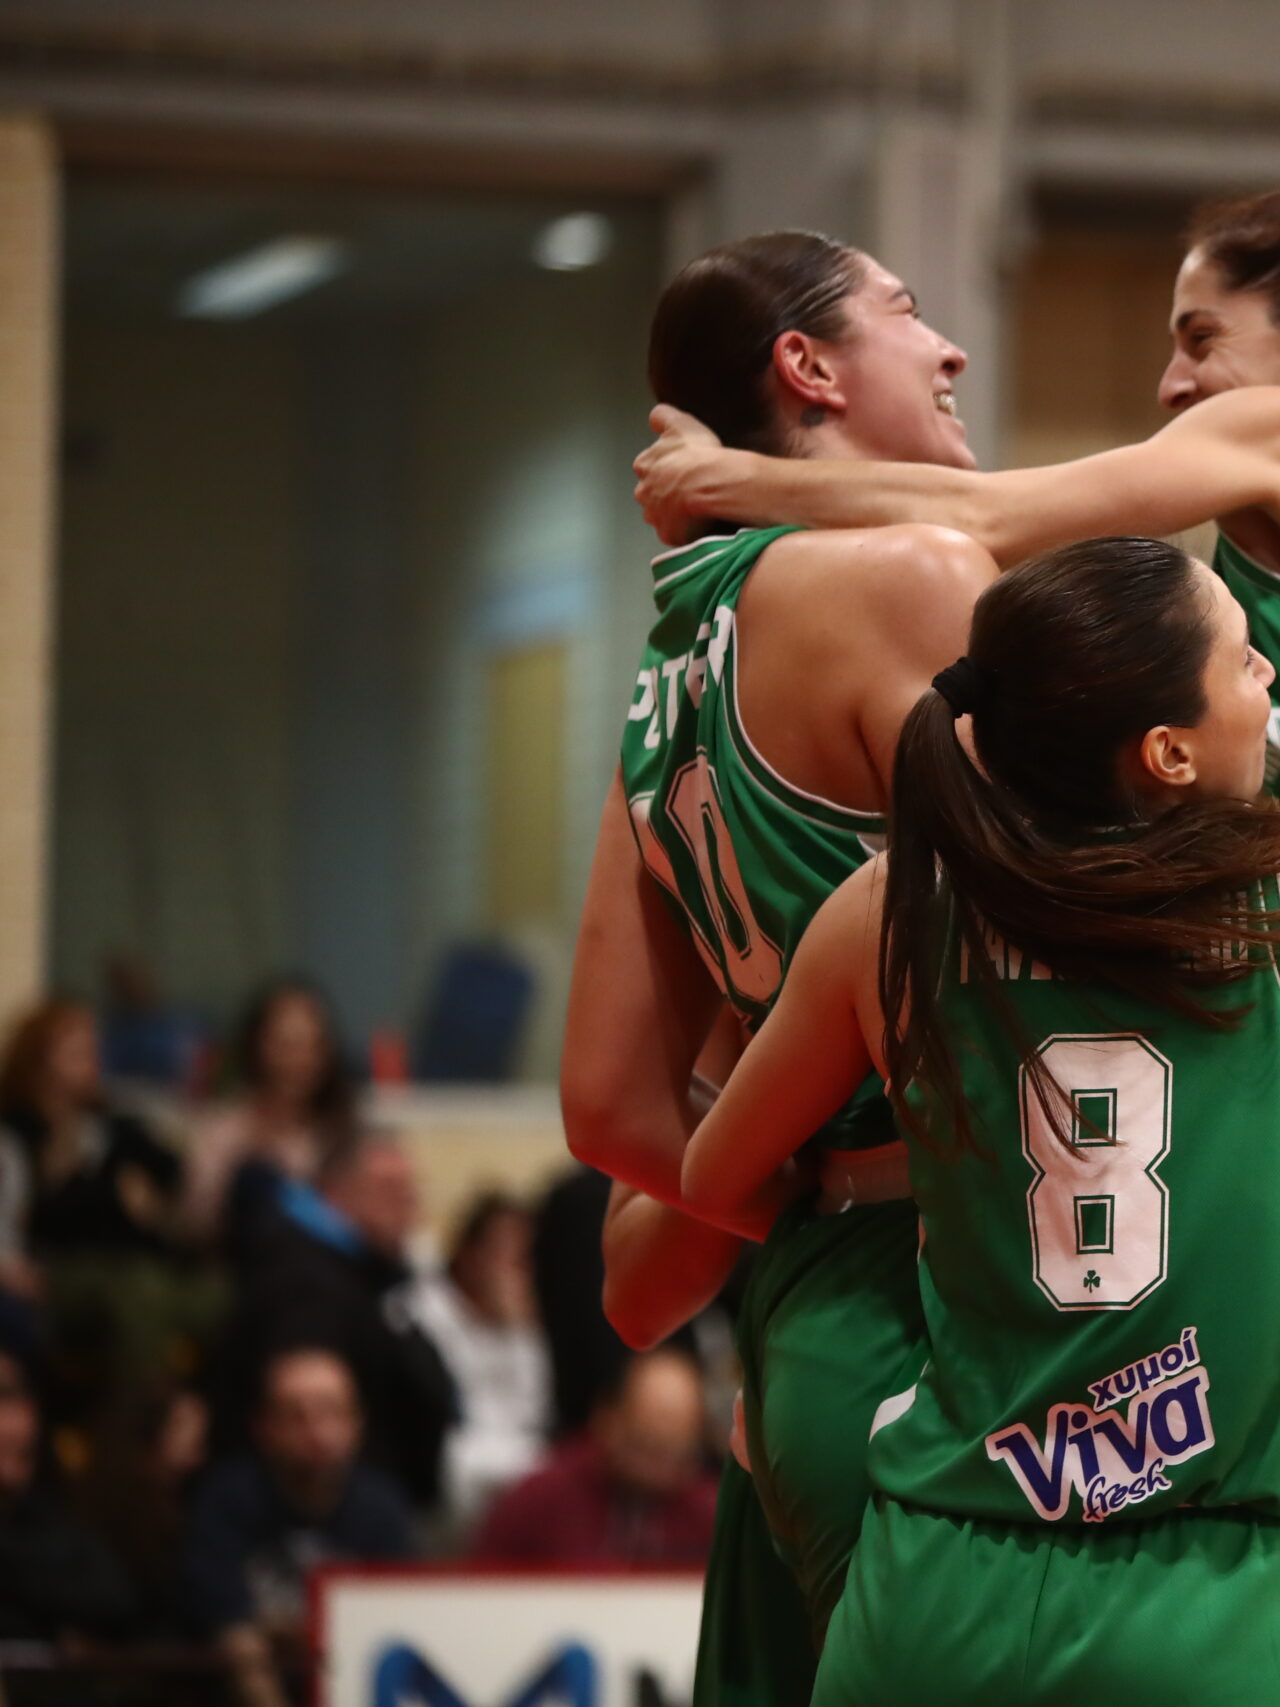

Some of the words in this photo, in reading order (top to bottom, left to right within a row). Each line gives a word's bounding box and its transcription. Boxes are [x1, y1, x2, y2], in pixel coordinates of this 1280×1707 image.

[1018, 1033, 1172, 1311] 8
[1091, 1329, 1197, 1409] χυμοί
[994, 1375, 1207, 1512] Viva
[1085, 1457, 1169, 1520] fresh
